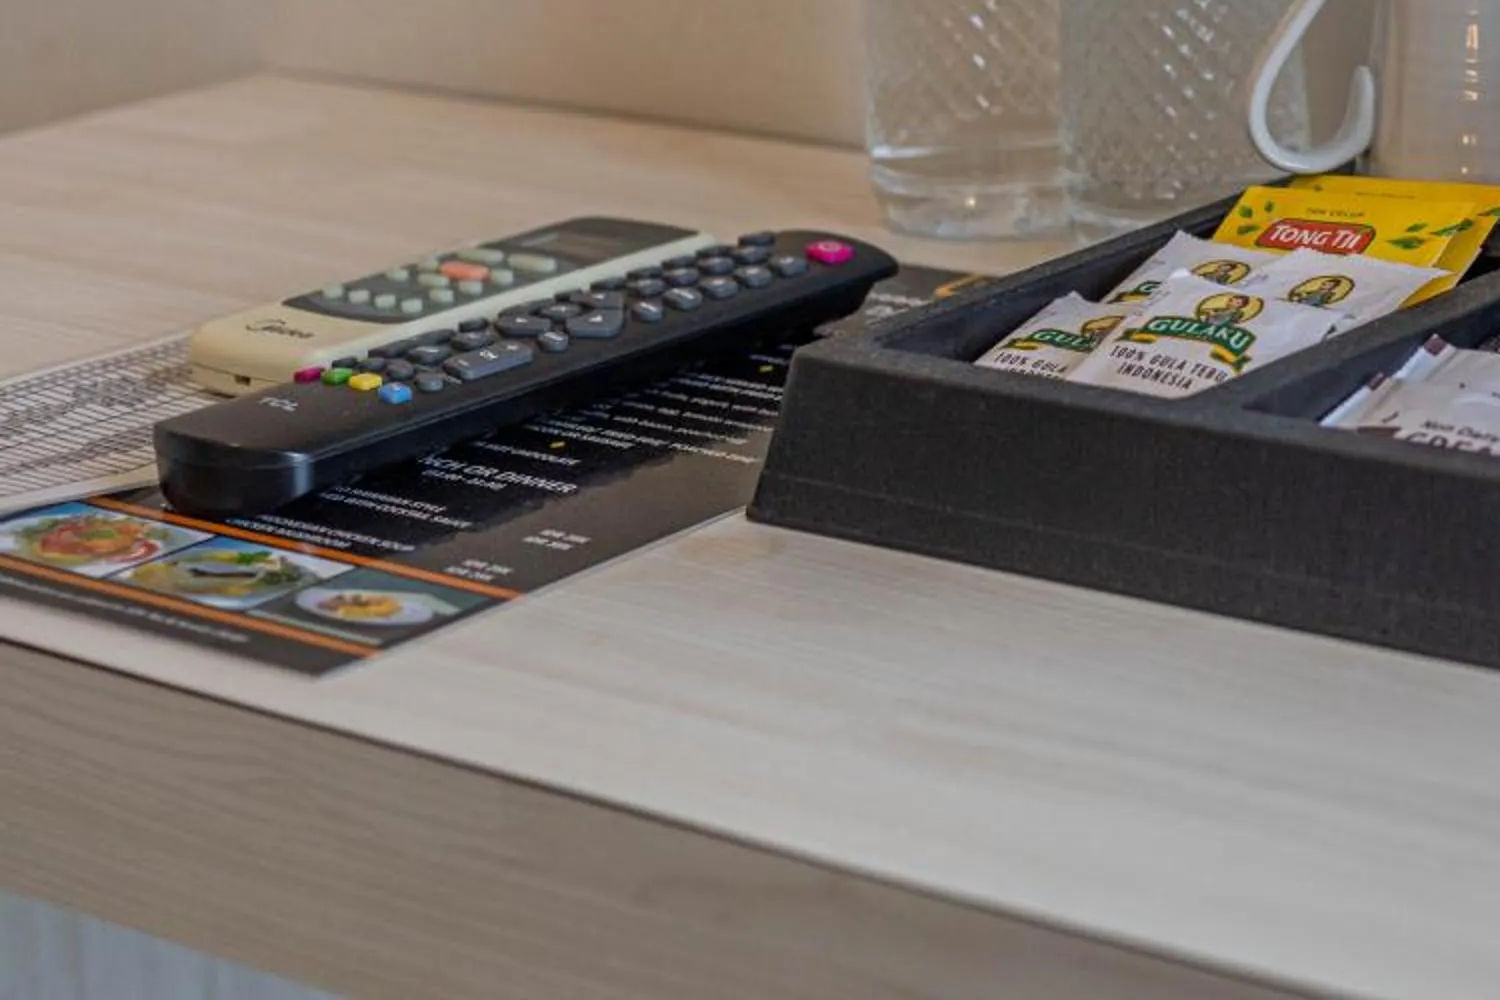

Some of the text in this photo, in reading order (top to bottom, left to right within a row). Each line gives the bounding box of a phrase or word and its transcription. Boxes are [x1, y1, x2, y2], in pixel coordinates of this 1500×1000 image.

[1269, 225, 1332, 246] TONG
[1149, 318, 1250, 350] GULAKU
[1110, 345, 1145, 361] 100%
[1150, 353, 1187, 371] GULA
[1116, 361, 1193, 390] INDONESIA
